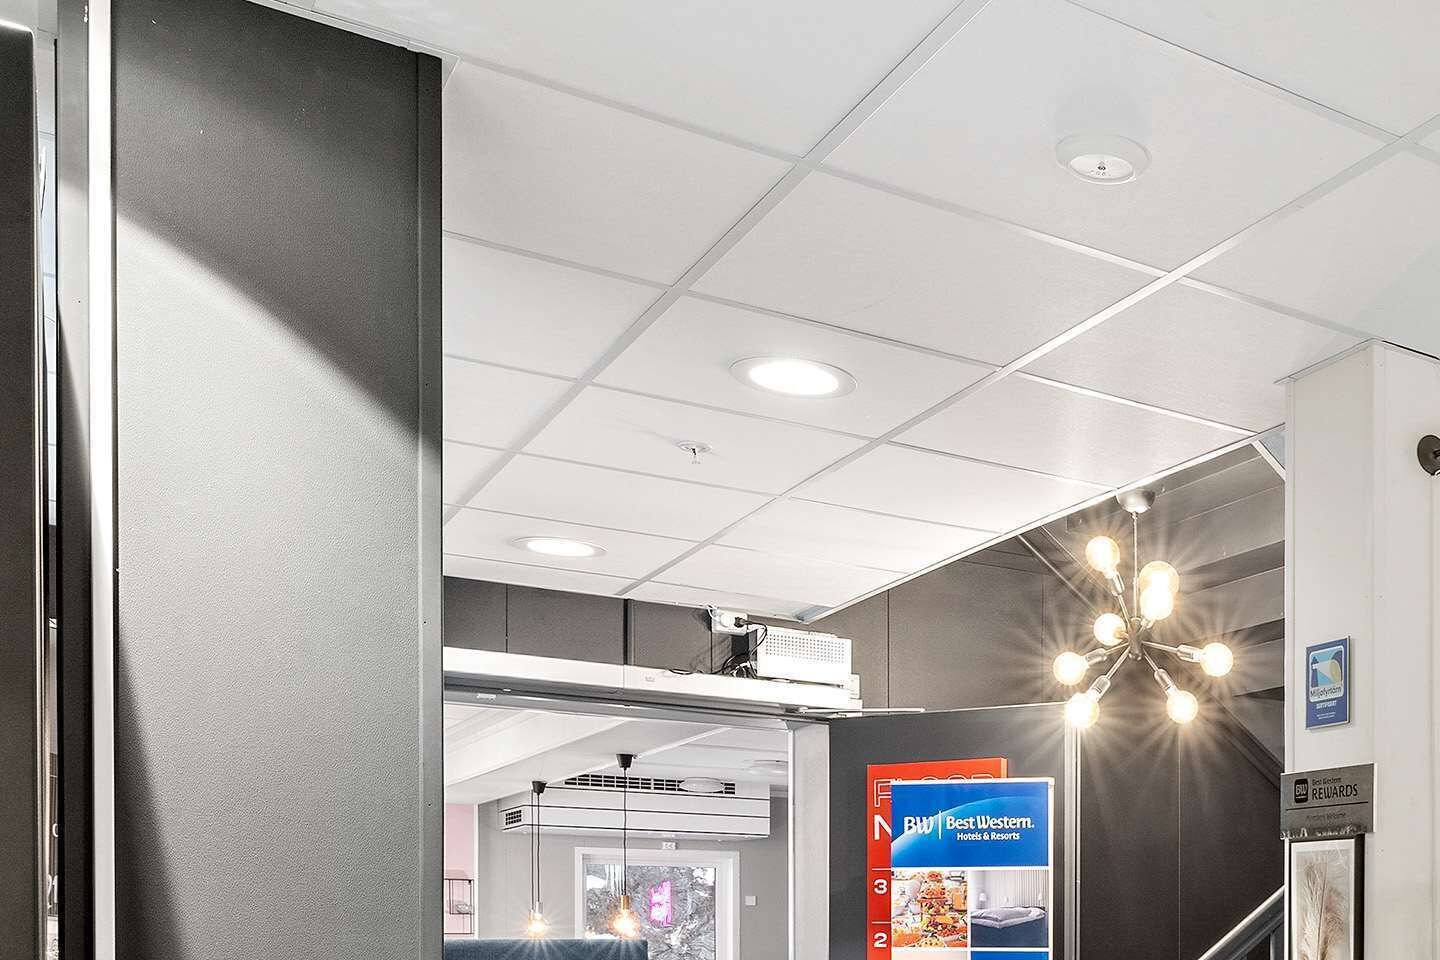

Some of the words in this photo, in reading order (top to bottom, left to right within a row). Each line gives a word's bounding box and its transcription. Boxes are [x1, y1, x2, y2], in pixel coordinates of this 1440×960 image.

[1312, 783, 1358, 801] REWARDS
[904, 815, 934, 834] BW
[946, 816, 976, 829] Best
[957, 832, 982, 841] Hotels
[983, 832, 989, 840] &
[991, 832, 1020, 841] Resorts
[873, 879, 887, 894] 3
[873, 932, 887, 948] 2
